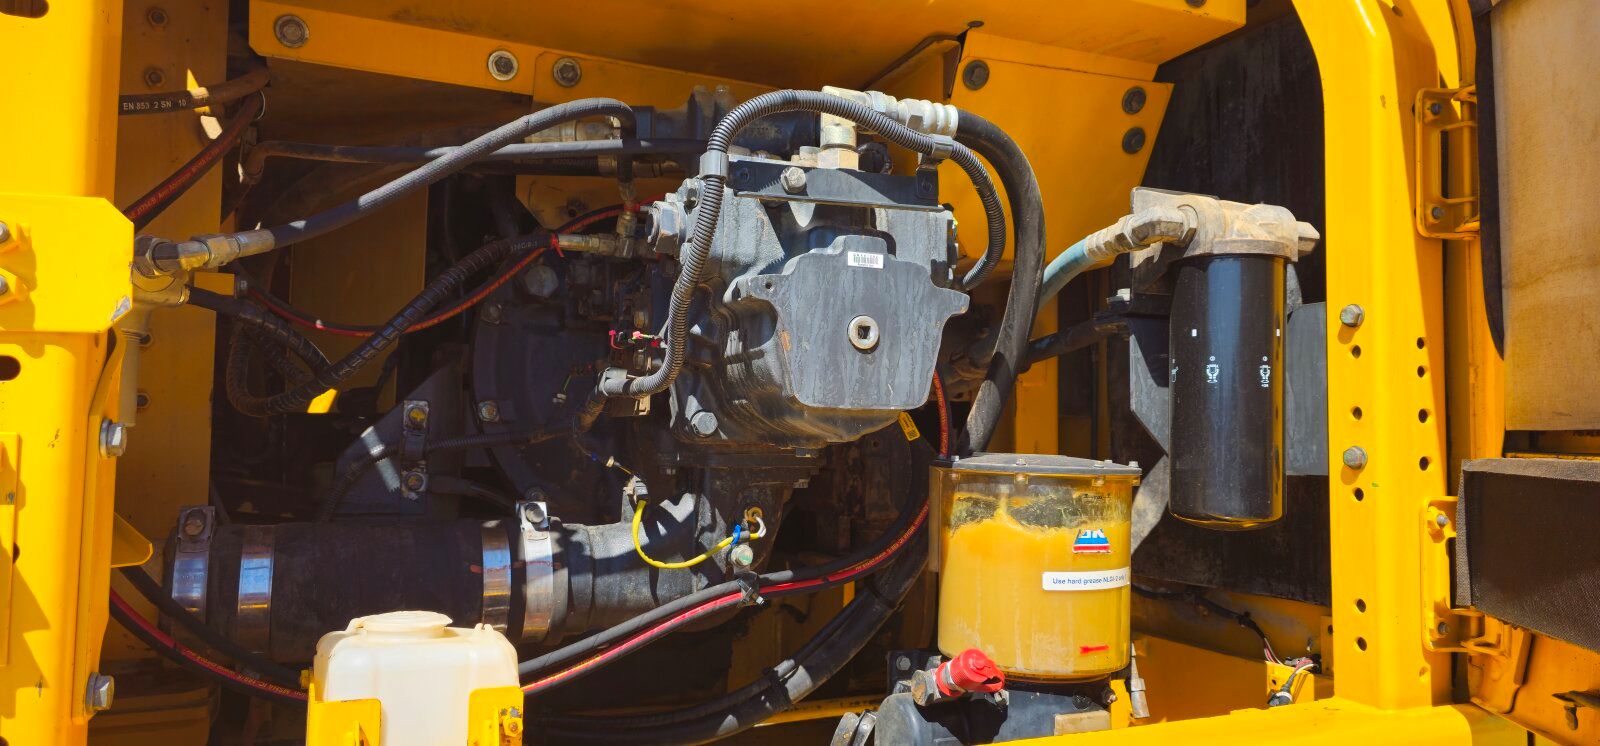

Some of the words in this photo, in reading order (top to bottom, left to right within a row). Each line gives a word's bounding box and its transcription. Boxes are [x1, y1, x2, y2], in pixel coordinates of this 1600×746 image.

[123, 102, 135, 111] EN
[136, 102, 150, 110] 853
[153, 101, 159, 109] 2
[160, 100, 172, 108] SN
[1052, 577, 1066, 585] Use
[1083, 577, 1102, 586] grease
